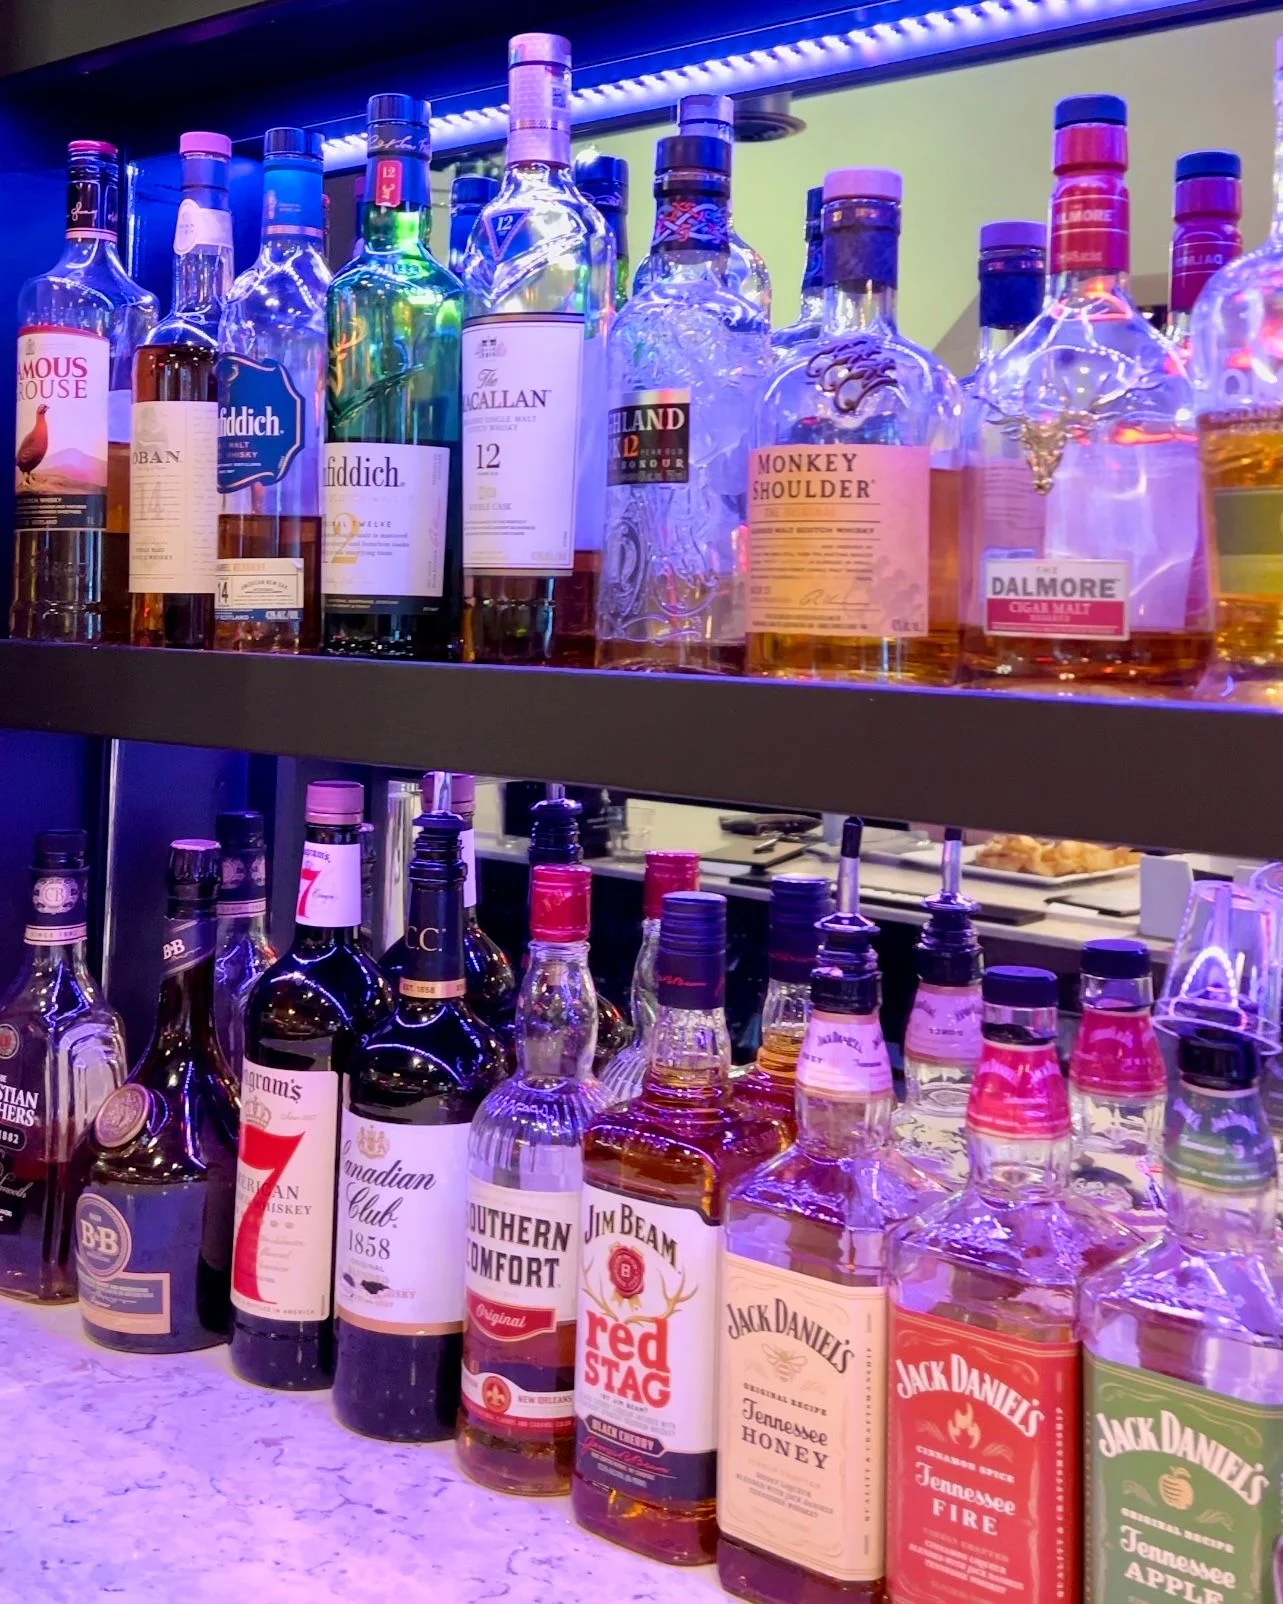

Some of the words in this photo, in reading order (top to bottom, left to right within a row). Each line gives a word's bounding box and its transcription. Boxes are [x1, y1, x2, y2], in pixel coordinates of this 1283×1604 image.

[383, 167, 396, 178] 12
[496, 216, 514, 232] 12
[476, 443, 501, 470] 12
[758, 453, 858, 475] MONKEY
[752, 479, 870, 500] SHOULDER
[991, 577, 1117, 599] DALMORE
[1051, 603, 1092, 616] MALT
[298, 867, 321, 918] 7
[232, 1123, 306, 1305] 7
[584, 1204, 616, 1245] JIM
[620, 1202, 678, 1268] BEAM
[348, 1228, 391, 1260] 1858
[475, 1303, 526, 1329] Original
[727, 1303, 773, 1340] JACK
[774, 1298, 856, 1374] DANIEL'S
[585, 1309, 672, 1375] red
[584, 1350, 672, 1409] STAG
[743, 1382, 788, 1404] ORIGINAL
[789, 1399, 828, 1416] RECIPE
[895, 1358, 950, 1399] JACK
[950, 1353, 1046, 1438] DANIEL'S
[742, 1397, 829, 1447] Tennessee
[741, 1424, 829, 1470] HONEY
[1095, 1412, 1161, 1459] JACK
[1160, 1409, 1271, 1506] DANIEL'S
[914, 1461, 1016, 1516] Tennessee
[931, 1497, 998, 1537] FIRE
[1119, 1506, 1183, 1537] ORIGINAL
[1183, 1528, 1236, 1555] RECIPE
[1119, 1524, 1237, 1590] Tennessee
[1123, 1560, 1225, 1604] APPLE
